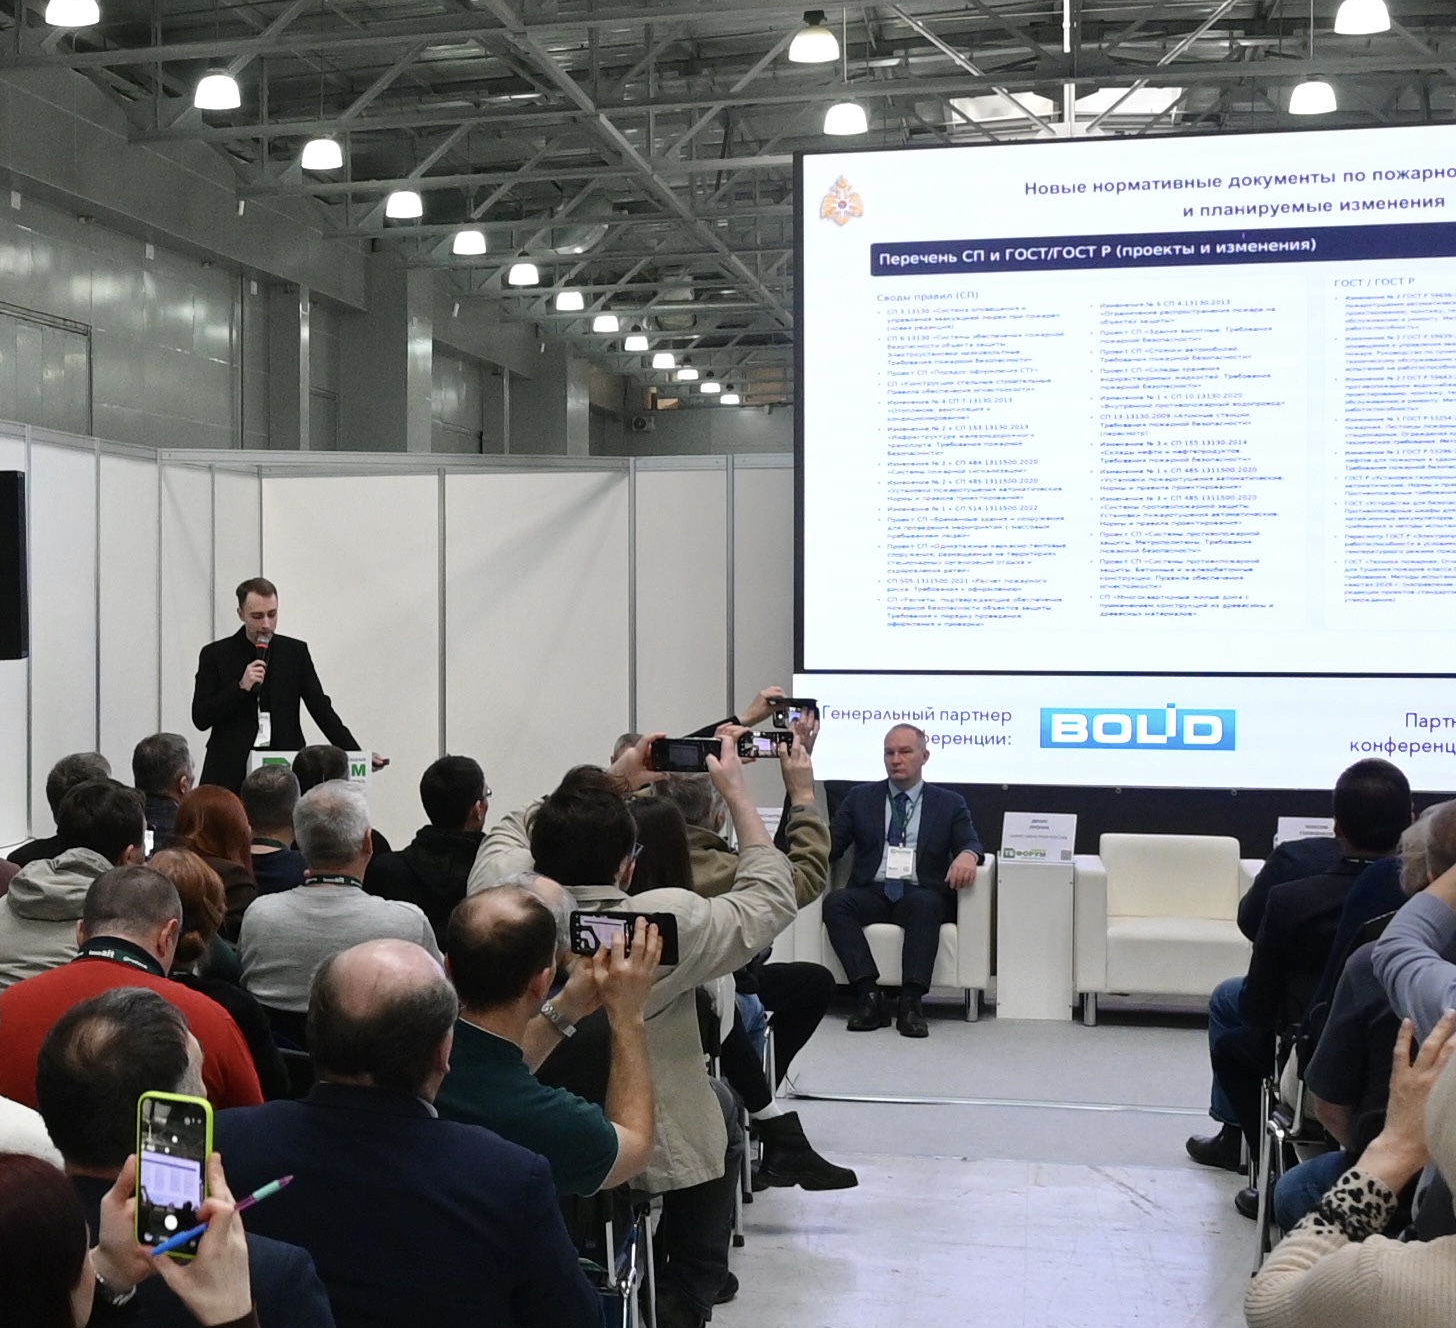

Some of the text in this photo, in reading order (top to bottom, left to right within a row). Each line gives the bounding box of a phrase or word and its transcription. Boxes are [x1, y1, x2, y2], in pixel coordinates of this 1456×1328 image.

[1025, 181, 1087, 195] Новые
[1093, 175, 1222, 194] нормативные
[1228, 173, 1336, 189] документы
[1344, 171, 1365, 181] по
[1184, 197, 1445, 218] и планируемые изменения
[879, 238, 1316, 267] Перечень СП и ГОСТ/ГОСТ Р (проекты и изменения)
[822, 705, 1012, 724] Генеральный партнер
